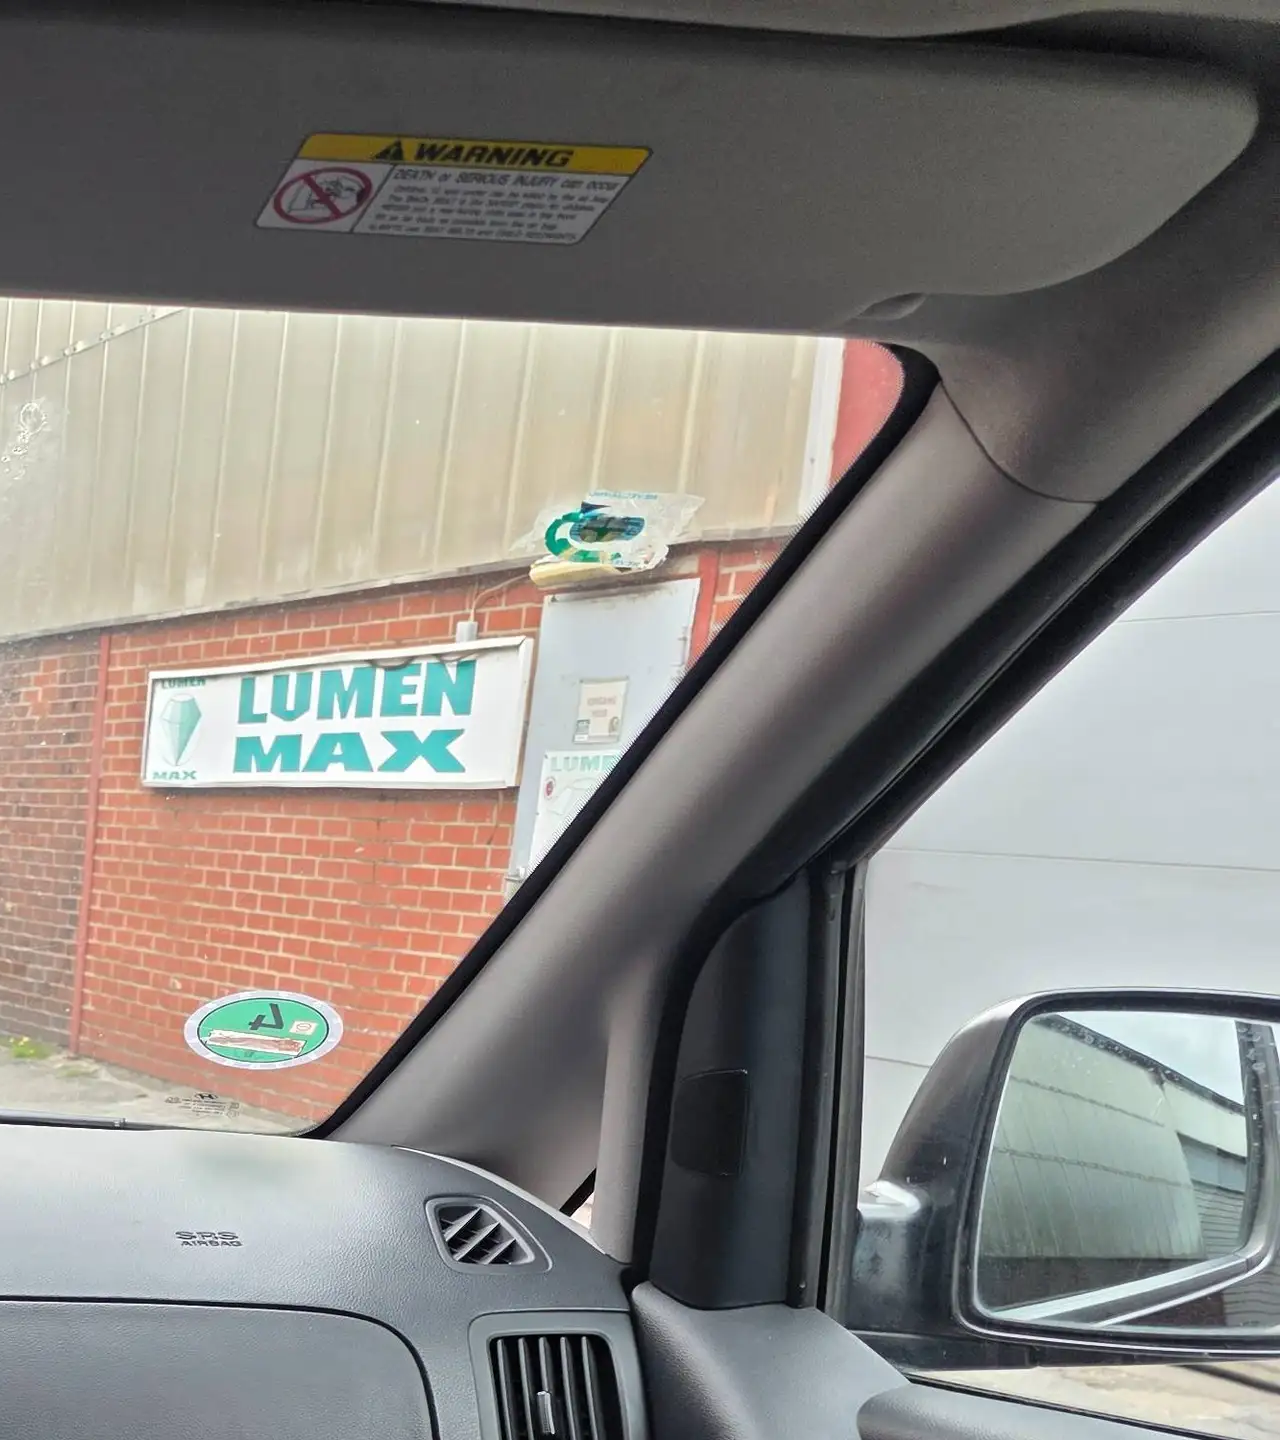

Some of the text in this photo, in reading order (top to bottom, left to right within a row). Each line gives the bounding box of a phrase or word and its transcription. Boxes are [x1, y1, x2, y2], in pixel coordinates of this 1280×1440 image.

[413, 142, 574, 168] WARNING
[393, 168, 436, 182] DEATH
[455, 171, 508, 186] SERIOUS
[511, 174, 560, 189] INJURY
[159, 676, 207, 690] LUMEN
[237, 659, 477, 725] LUMEN
[233, 728, 466, 774] MAX
[152, 769, 197, 781] MAX
[175, 1231, 239, 1240] SRS
